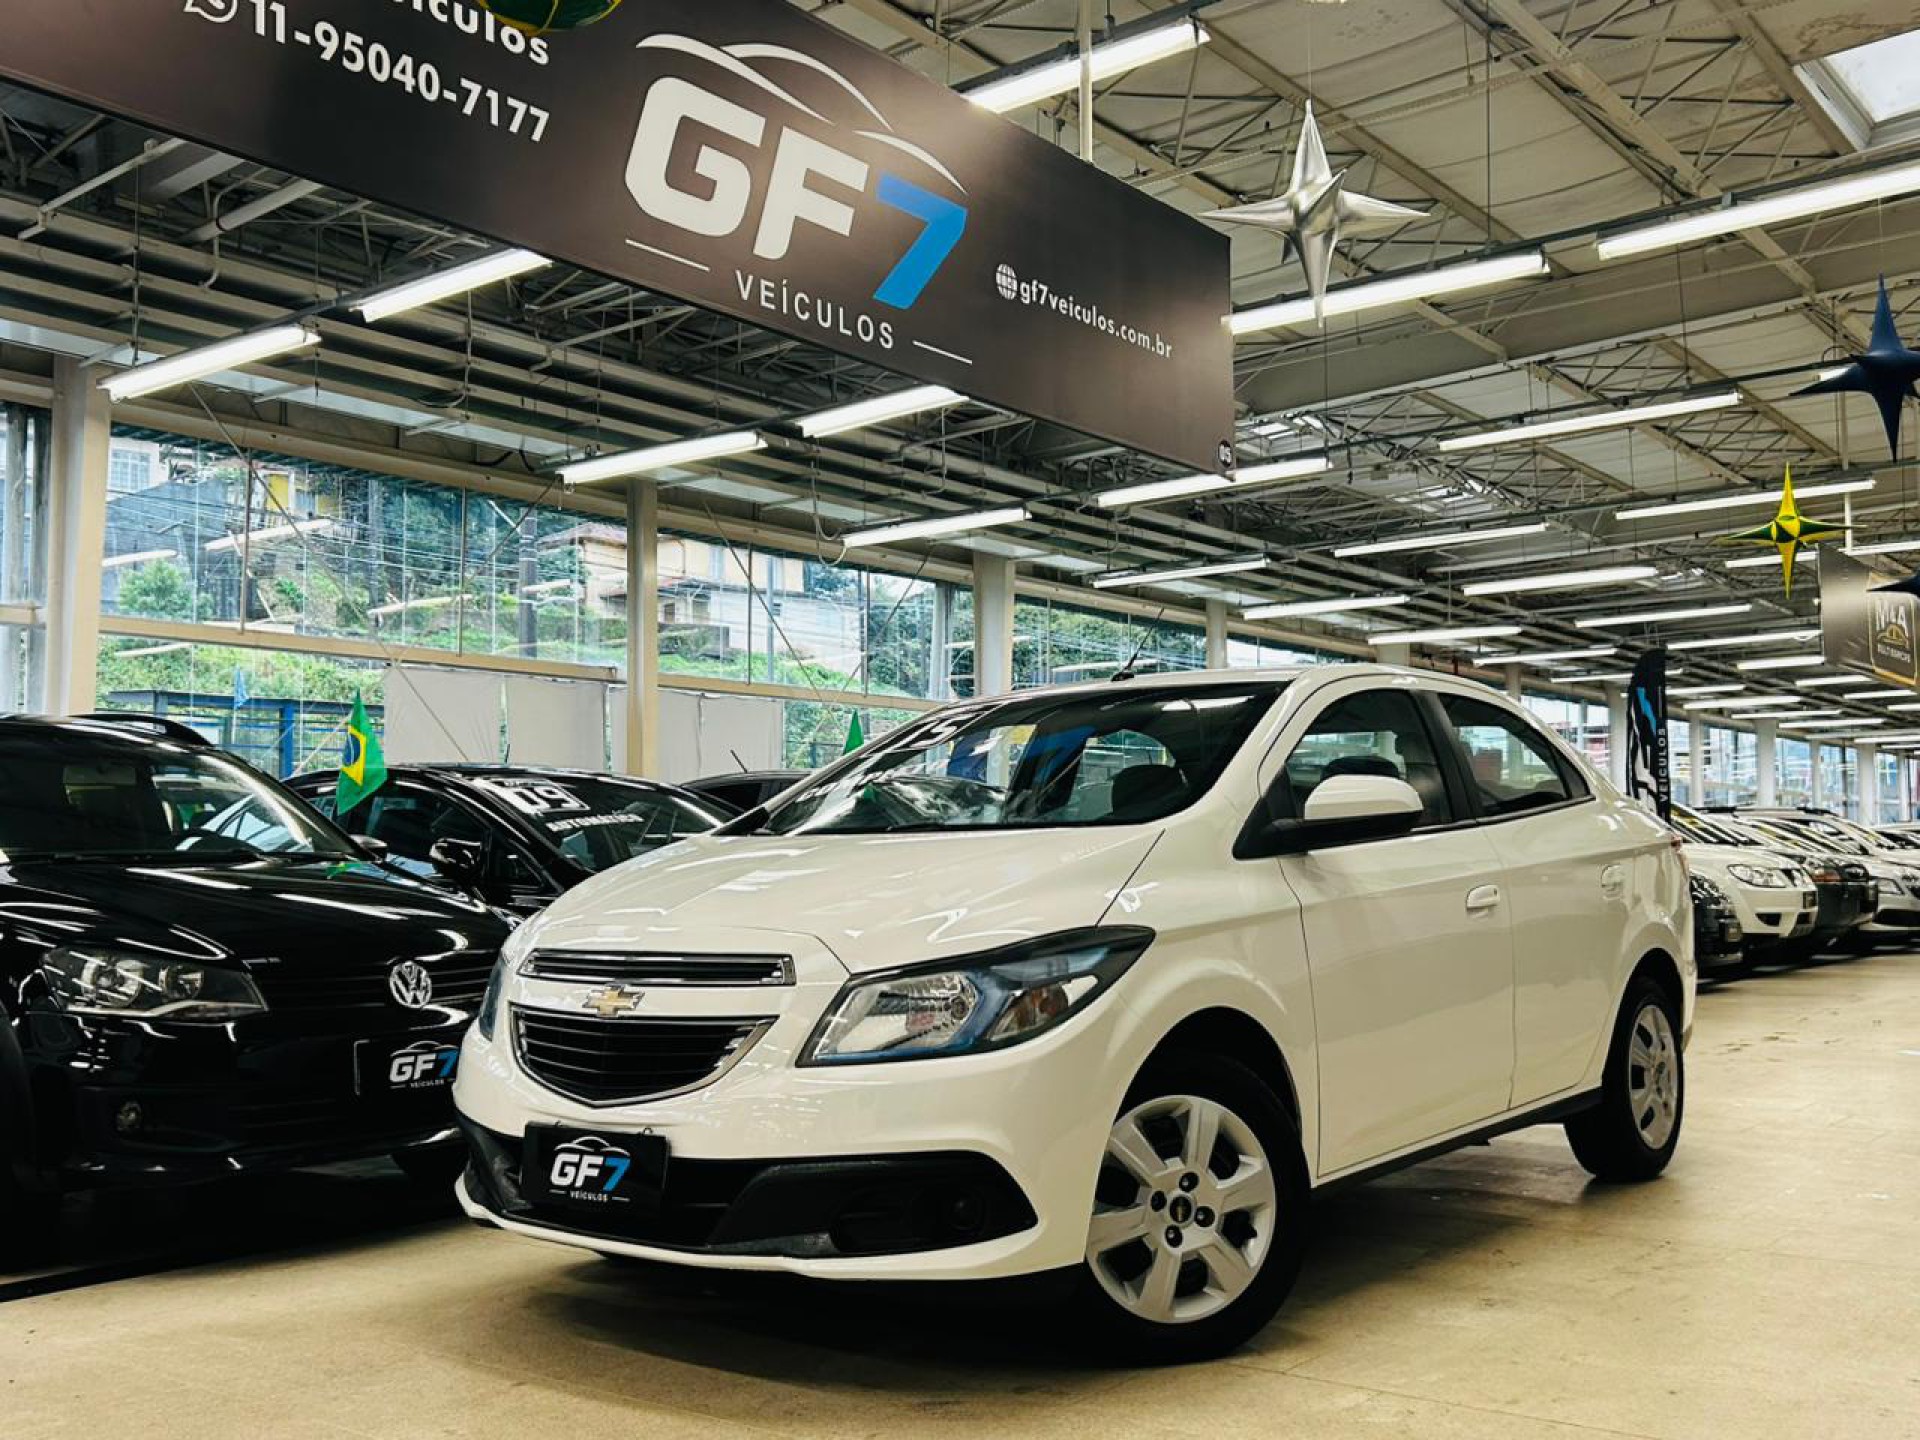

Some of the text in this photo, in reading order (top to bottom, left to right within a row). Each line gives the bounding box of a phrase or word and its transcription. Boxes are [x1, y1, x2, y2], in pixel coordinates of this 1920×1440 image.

[250, 0, 549, 142] 11-95040-7177
[625, 77, 967, 309] GF7
[735, 269, 894, 349] VEÍCULOS
[1020, 279, 1172, 358] gf7veiculos.com.br
[390, 1050, 459, 1082] GF7
[551, 1152, 630, 1191] GF7
